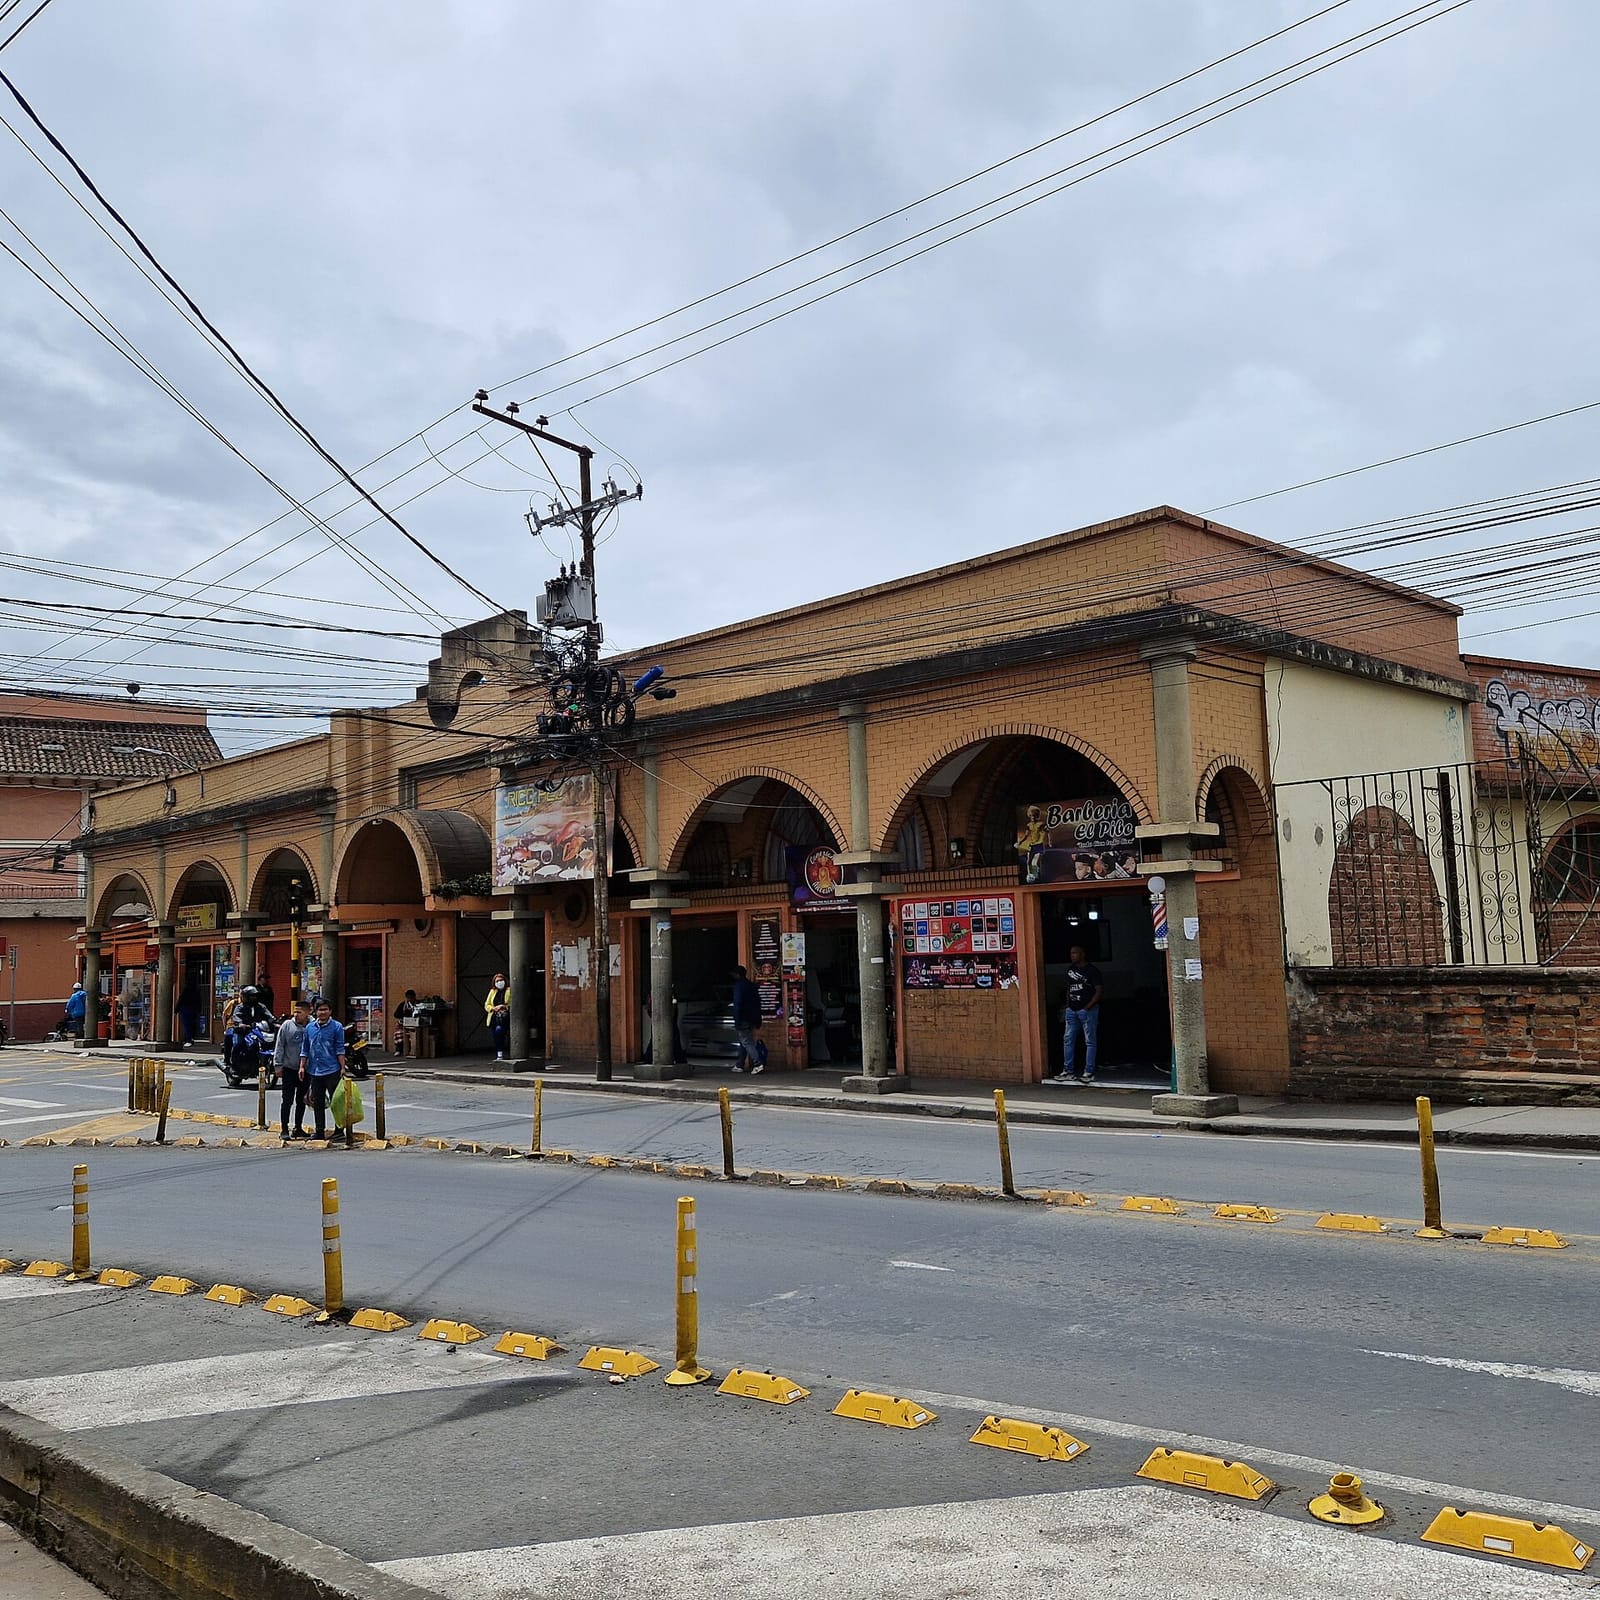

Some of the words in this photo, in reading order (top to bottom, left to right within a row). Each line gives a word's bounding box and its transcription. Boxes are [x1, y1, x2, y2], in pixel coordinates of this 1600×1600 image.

[1047, 798, 1133, 829] Barberia
[1074, 822, 1096, 840] El
[1099, 818, 1134, 838] Pibe
[175, 920, 202, 929] VILLA
